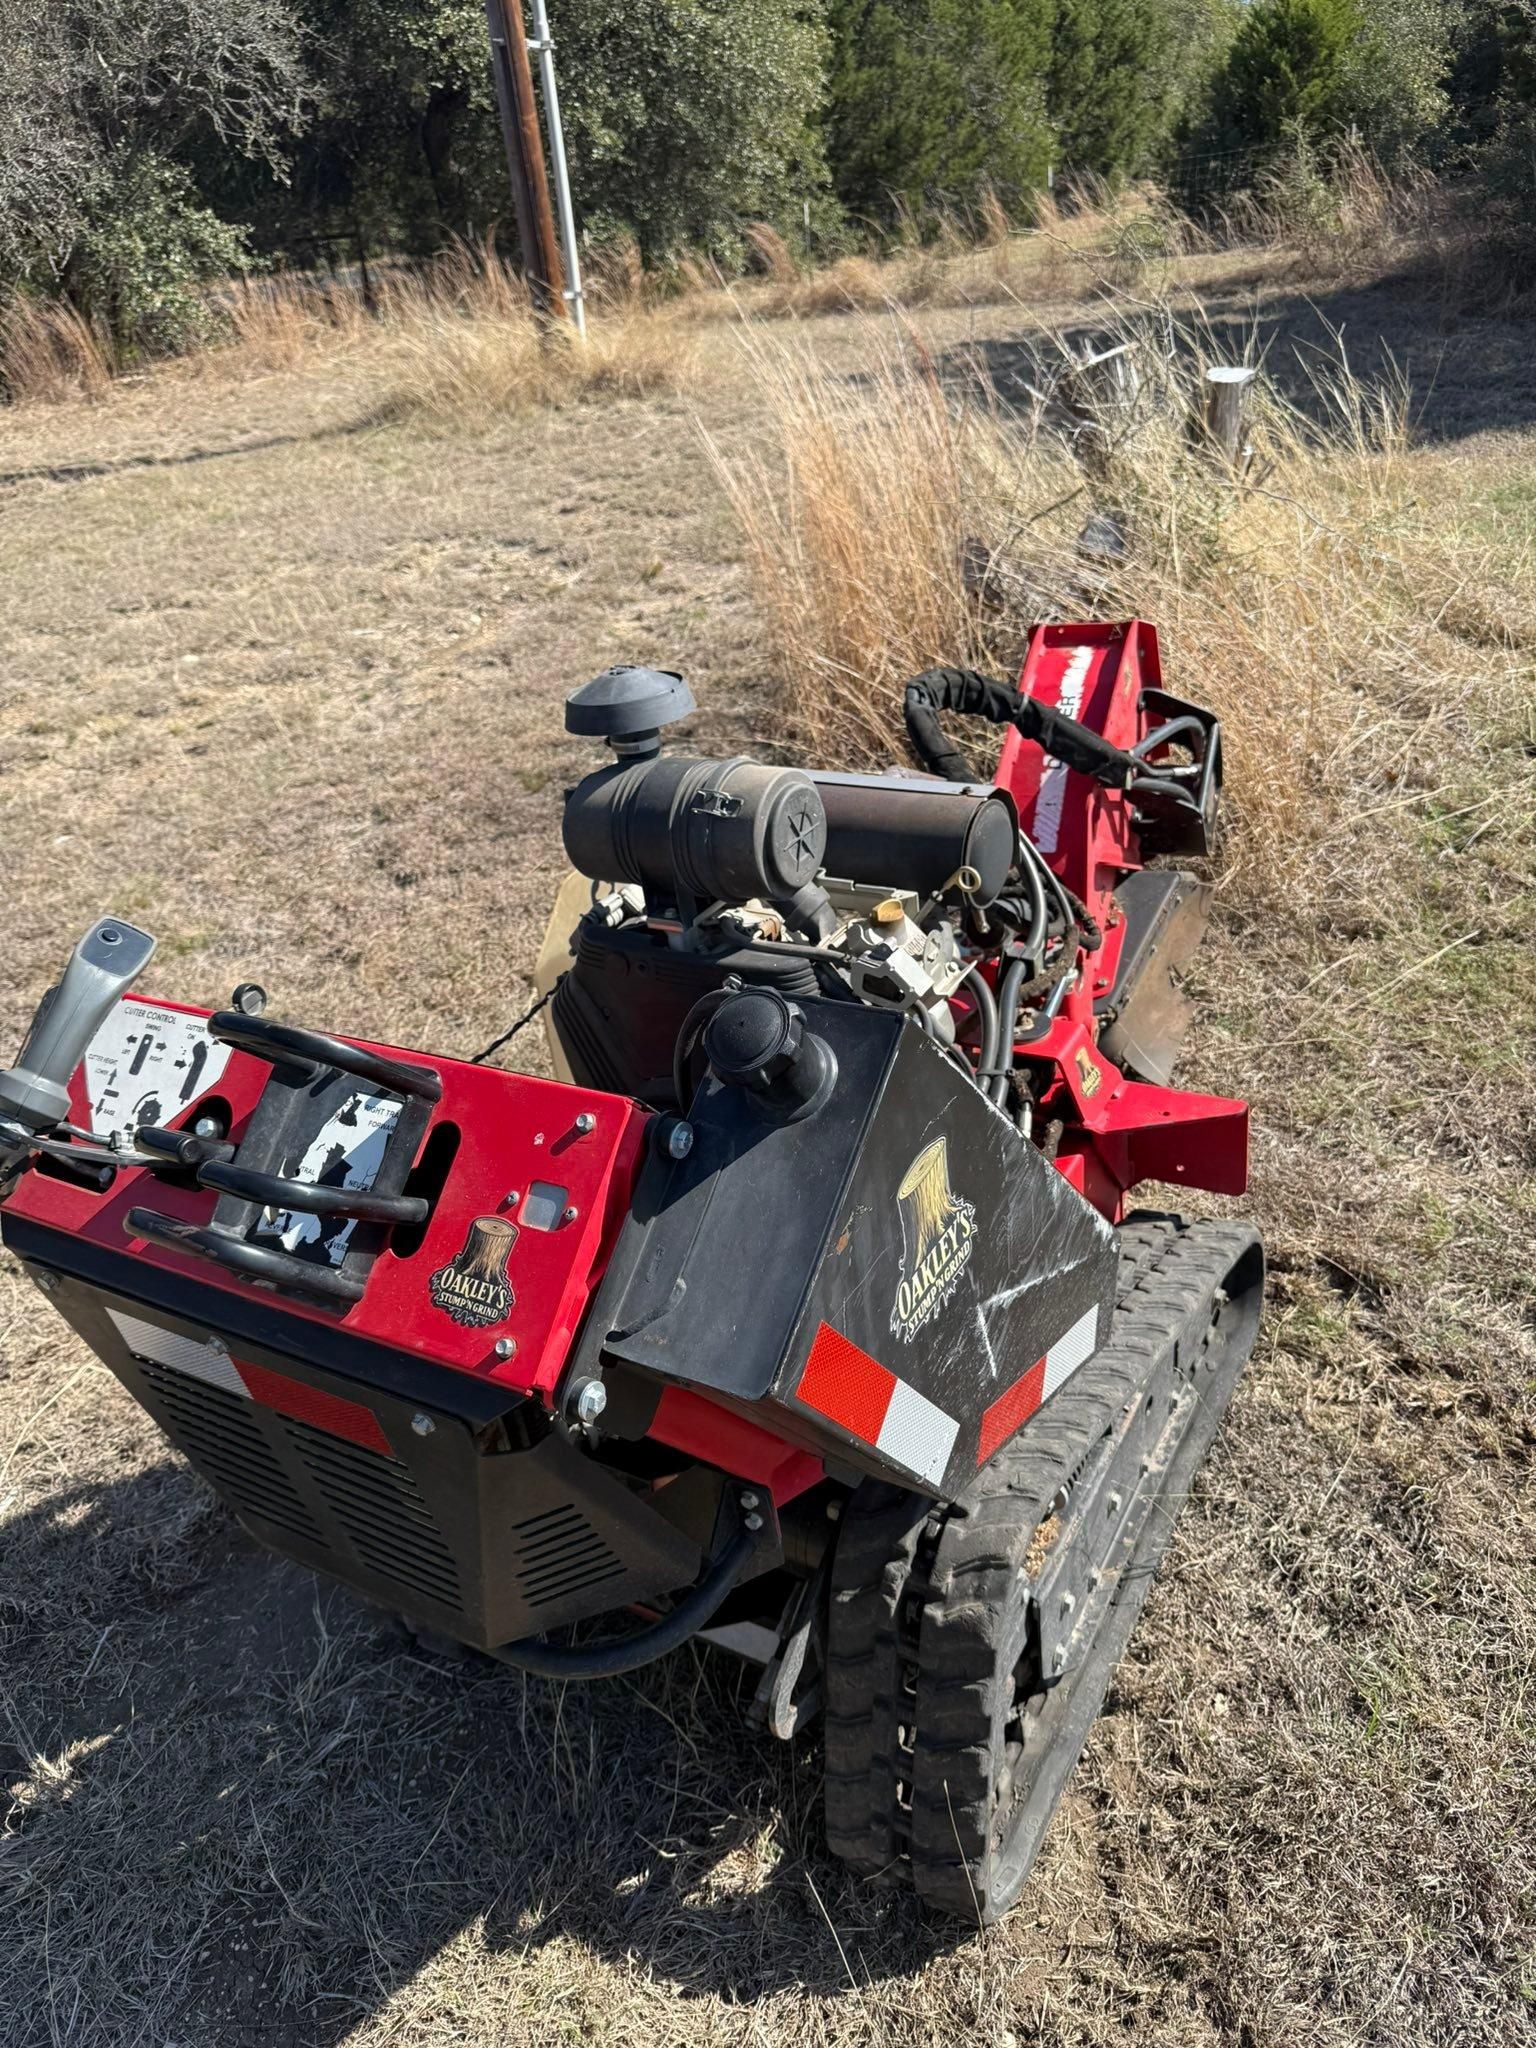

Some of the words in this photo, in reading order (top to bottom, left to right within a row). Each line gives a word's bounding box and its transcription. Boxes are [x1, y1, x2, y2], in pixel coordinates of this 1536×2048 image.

[124, 1006, 146, 1018] CUTTER
[146, 1011, 177, 1024] CONTROL
[185, 1023, 206, 1032] CUTTER
[364, 1104, 385, 1117] RIGHT
[367, 1120, 396, 1132] FORWAR
[898, 1209, 971, 1321] OAKLEY'S
[440, 1267, 508, 1310] OAKLEY'S
[472, 1302, 499, 1319] GRIND
